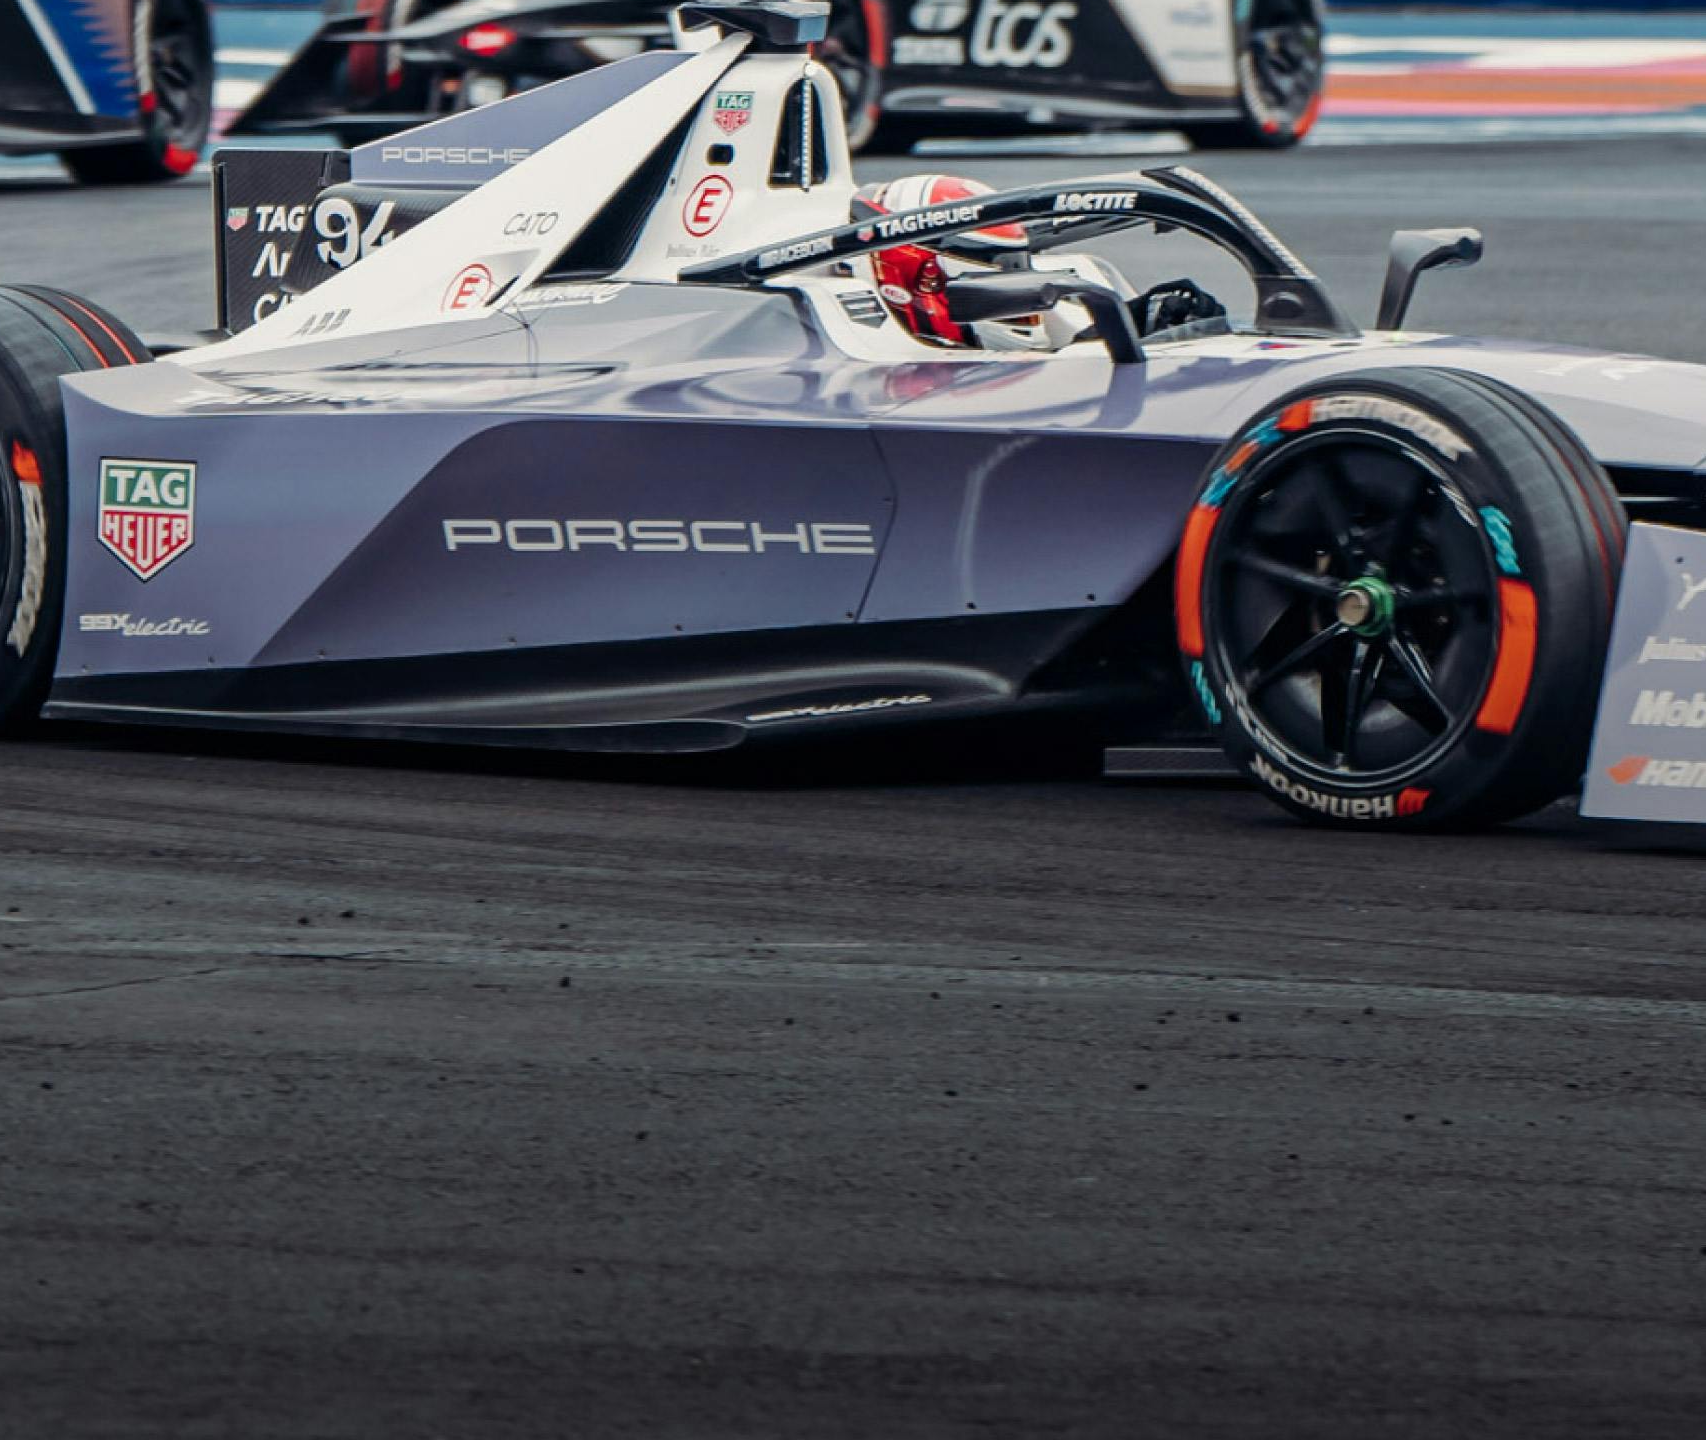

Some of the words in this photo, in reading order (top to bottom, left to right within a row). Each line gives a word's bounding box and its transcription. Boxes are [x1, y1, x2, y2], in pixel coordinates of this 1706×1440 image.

[382, 146, 533, 165] PORSCHE
[1054, 192, 1138, 211] LOCTITE
[315, 197, 397, 269] 94
[504, 211, 559, 236] CATO
[109, 471, 186, 506] TAG
[104, 511, 188, 570] HEUER
[443, 518, 874, 555] PORSCHE
